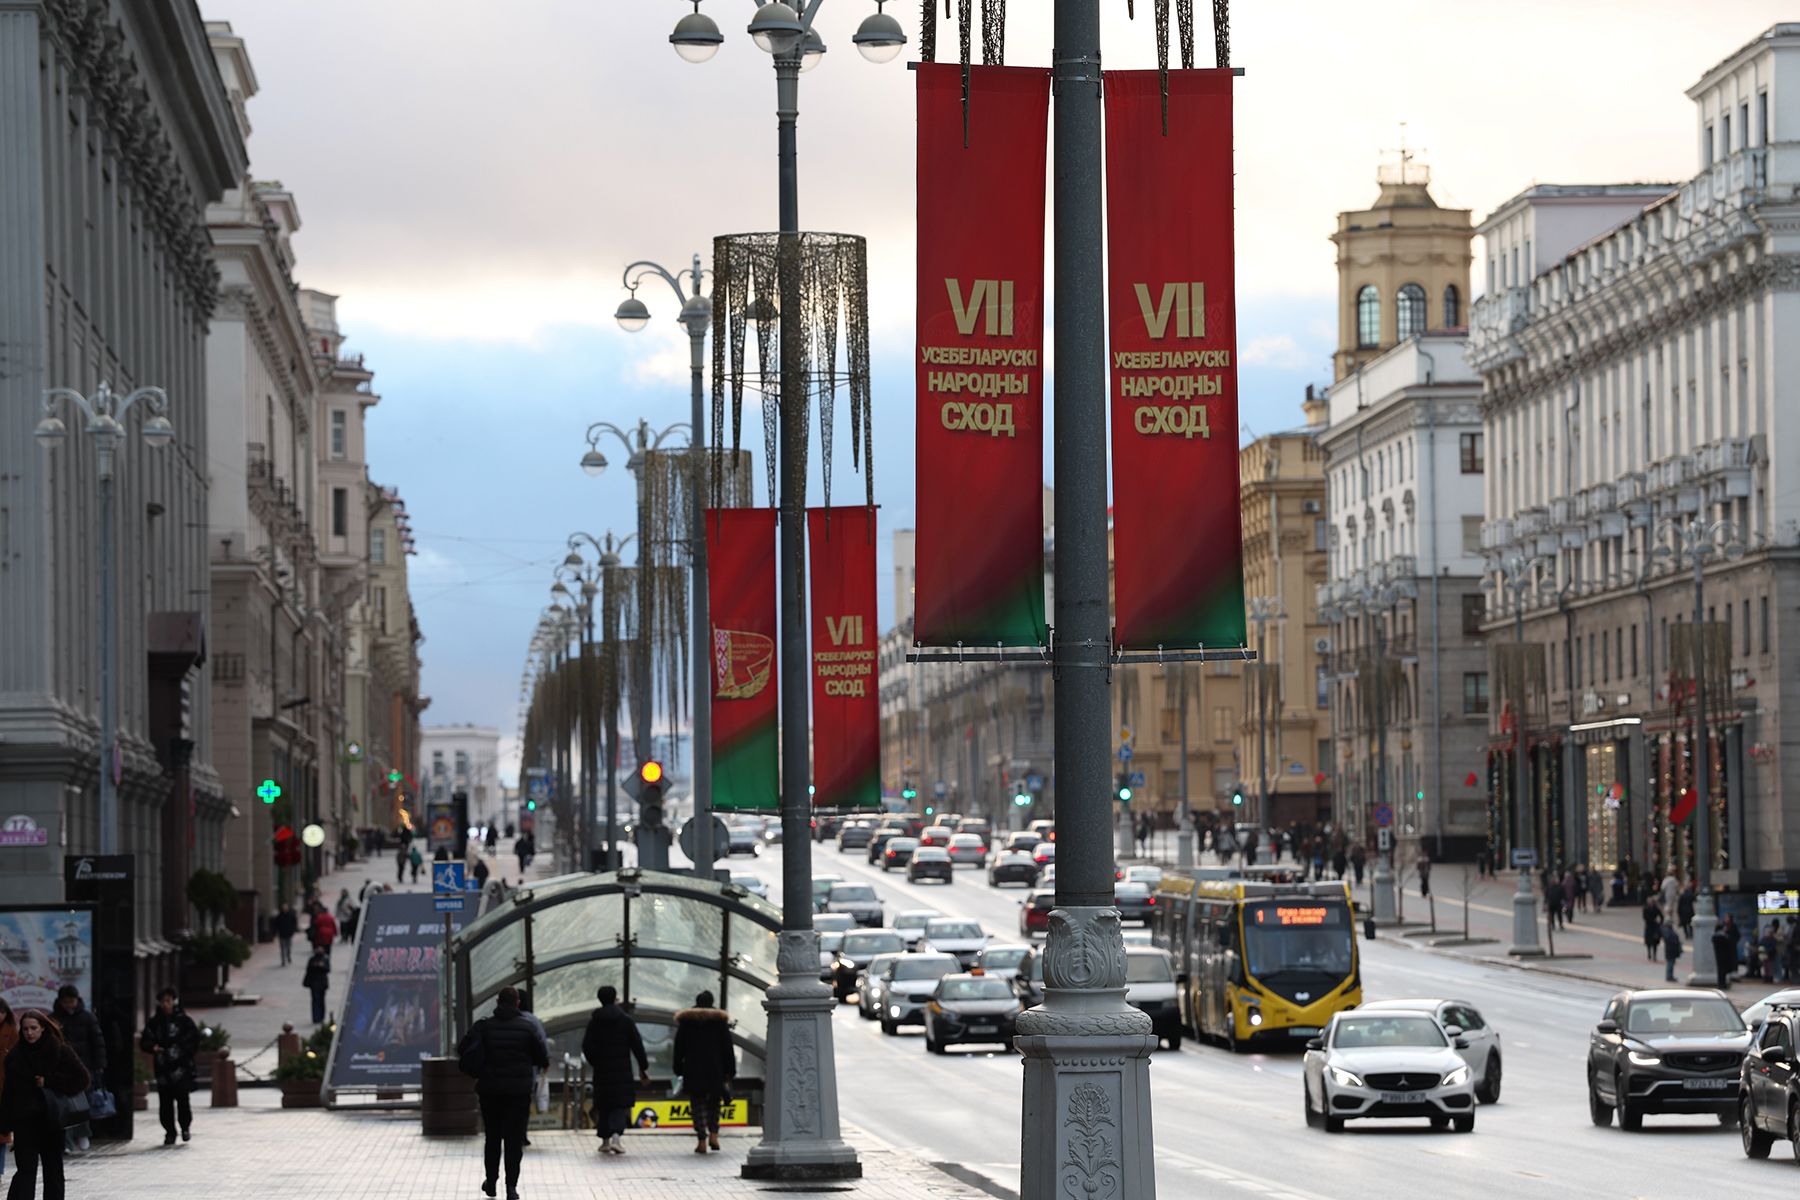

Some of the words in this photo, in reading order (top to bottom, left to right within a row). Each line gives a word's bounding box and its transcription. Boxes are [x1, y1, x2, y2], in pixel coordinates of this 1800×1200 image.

[944, 278, 1014, 336] VII
[1133, 282, 1206, 338] VII
[921, 346, 1038, 366] УСЕБЕЛАРУСКІ
[1114, 350, 1230, 369] УСЕБЕЛАРУСКІ
[928, 371, 1029, 398] НАРОДНЫ
[1120, 375, 1222, 400] НАРОДНЫ
[941, 402, 1016, 437] СХОД
[1134, 405, 1210, 439] СХОД
[825, 615, 864, 646] VII
[814, 651, 875, 662] УСЕБЕЛАРУСКІ
[818, 663, 871, 677] НАРОДНЫ
[825, 679, 865, 697] СХОД
[1257, 910, 1264, 923] 1
